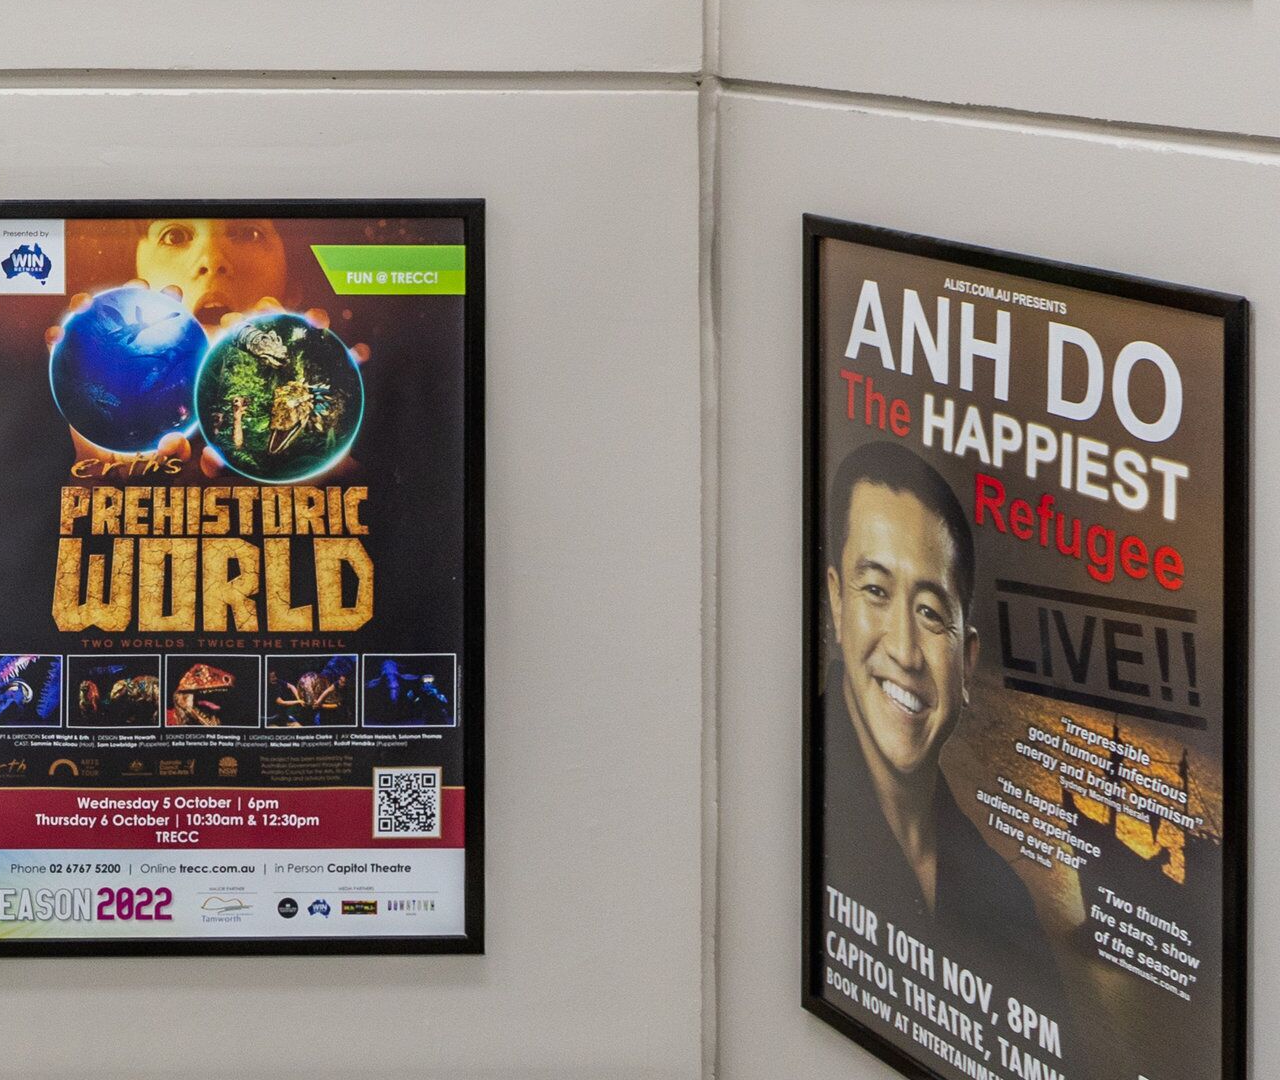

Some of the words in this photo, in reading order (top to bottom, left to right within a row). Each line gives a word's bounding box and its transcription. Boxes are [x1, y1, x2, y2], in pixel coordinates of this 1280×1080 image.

[11, 253, 44, 267] WIN
[346, 270, 372, 284] FUN
[376, 271, 388, 284] @
[390, 271, 437, 284] TRECC!
[943, 277, 1010, 302] ALIST.COM.AU
[1012, 292, 1067, 315] PRESENTS
[844, 279, 1010, 401] ANH
[1046, 321, 1183, 442] DO
[840, 369, 911, 438] The
[922, 393, 1189, 521] HAPPIEST
[59, 486, 368, 535] PREHISTORIC
[974, 473, 1184, 590] Refugee
[51, 537, 374, 632] WORLD
[997, 600, 1201, 707] LIVE!!
[76, 796, 159, 812] Wednesday
[162, 796, 170, 809] 5
[174, 796, 231, 809] October
[247, 796, 279, 811] 6pm
[155, 830, 199, 843] TRECC
[1090, 904, 1116, 928] five
[1118, 921, 1158, 951] stars,
[1161, 941, 1200, 970] show
[1098, 885, 1133, 914] “Two
[1136, 905, 1192, 946] thumbs,
[826, 885, 878, 946] THUR
[886, 922, 935, 981] 10TH
[942, 956, 998, 1026] NOV,
[1007, 997, 1062, 1059] 8PM
